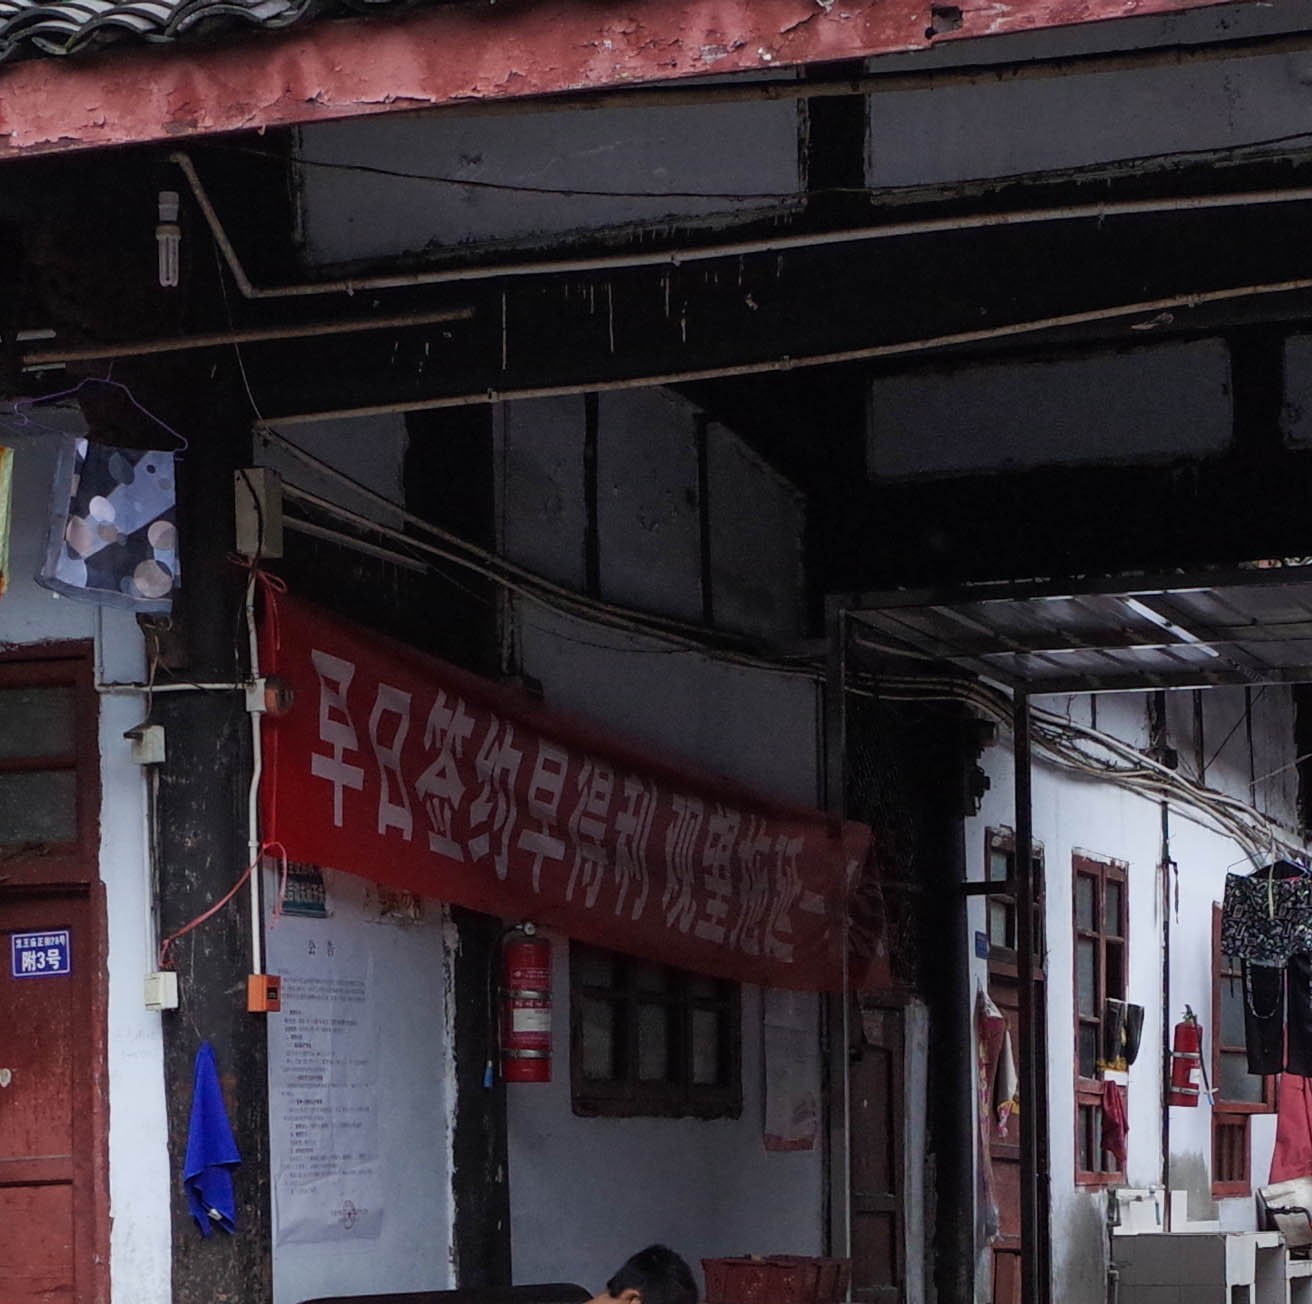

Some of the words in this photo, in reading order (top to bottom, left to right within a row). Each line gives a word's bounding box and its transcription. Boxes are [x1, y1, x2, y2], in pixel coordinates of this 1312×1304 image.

[310, 648, 658, 922] 早日签约早得利
[22, 949, 61, 971] 附3号
